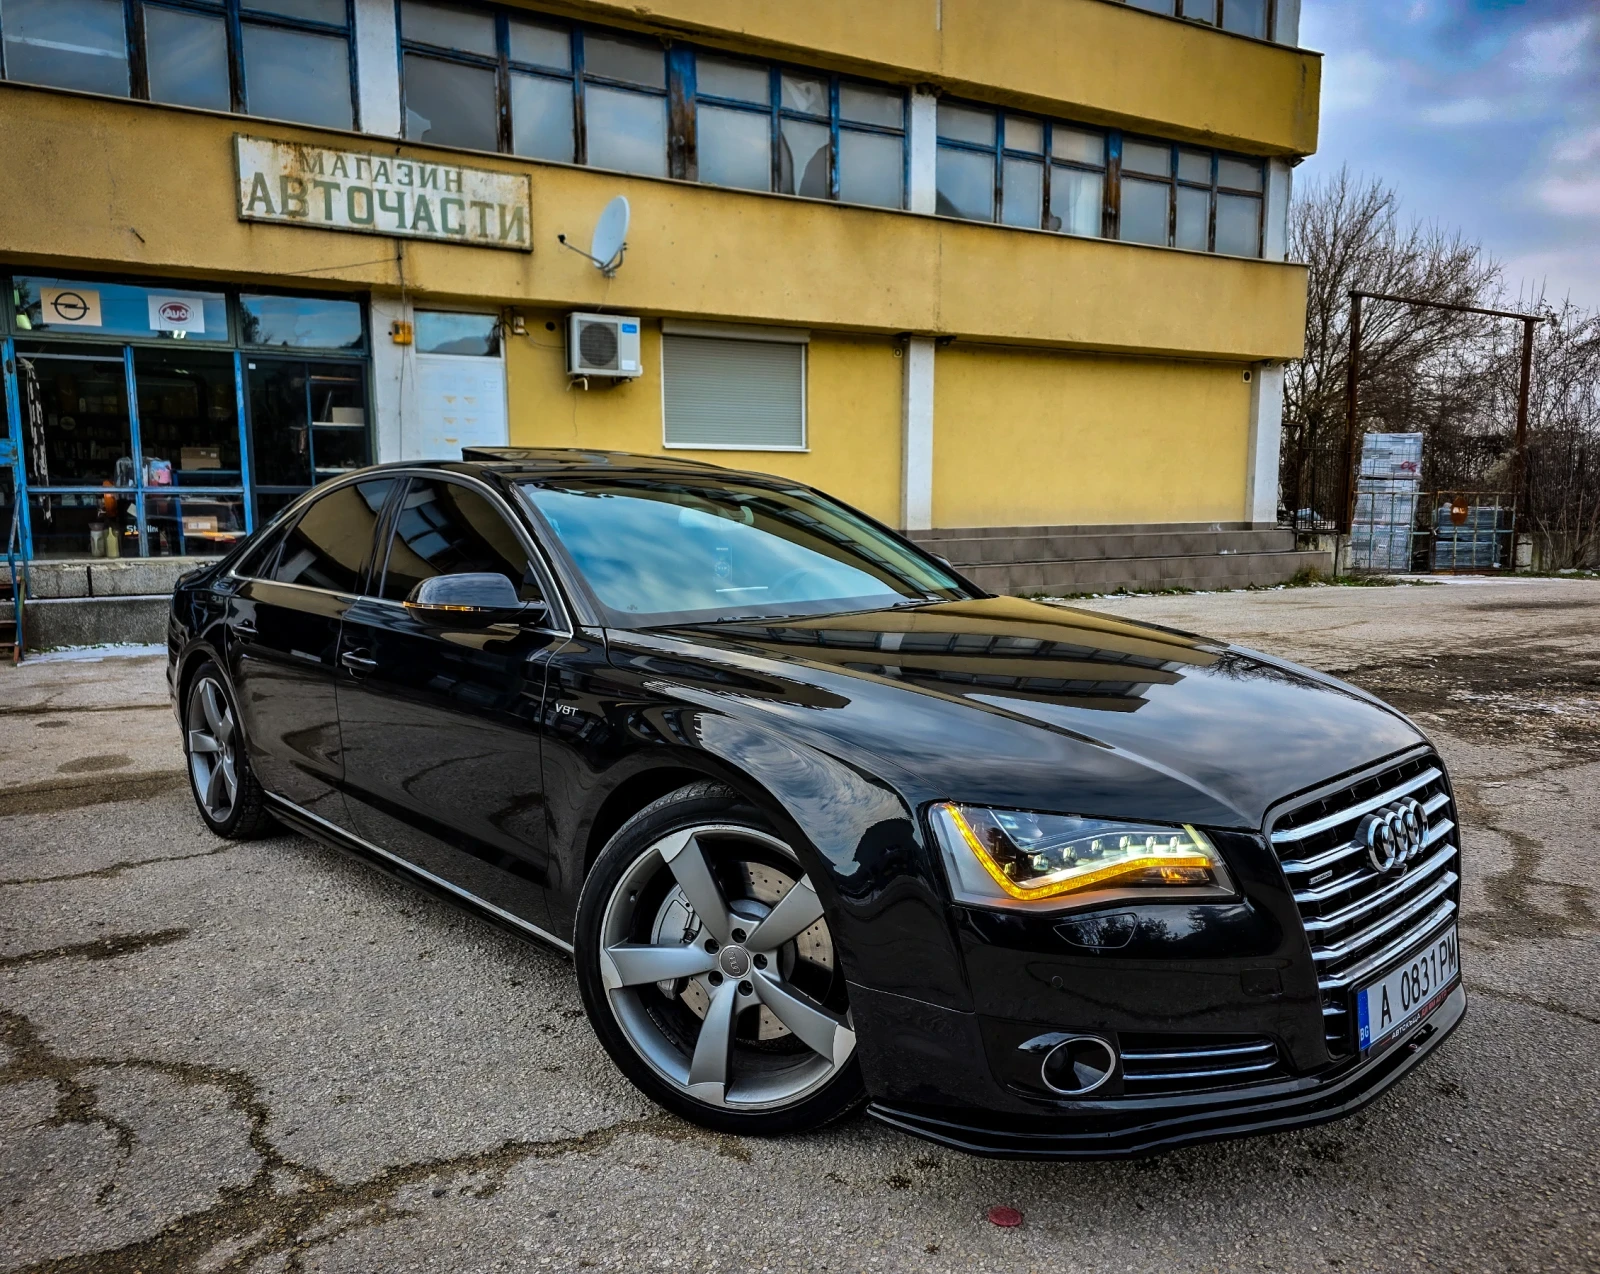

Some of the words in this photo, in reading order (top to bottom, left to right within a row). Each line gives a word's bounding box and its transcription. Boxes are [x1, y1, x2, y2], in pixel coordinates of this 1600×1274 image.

[300, 150, 464, 194] МАГАЗИН
[245, 171, 525, 243] АВТОЧАСТИ
[1401, 461, 1418, 473] OK
[555, 703, 579, 717] V8T
[1380, 984, 1392, 1029] A
[1360, 1025, 1369, 1042] BG
